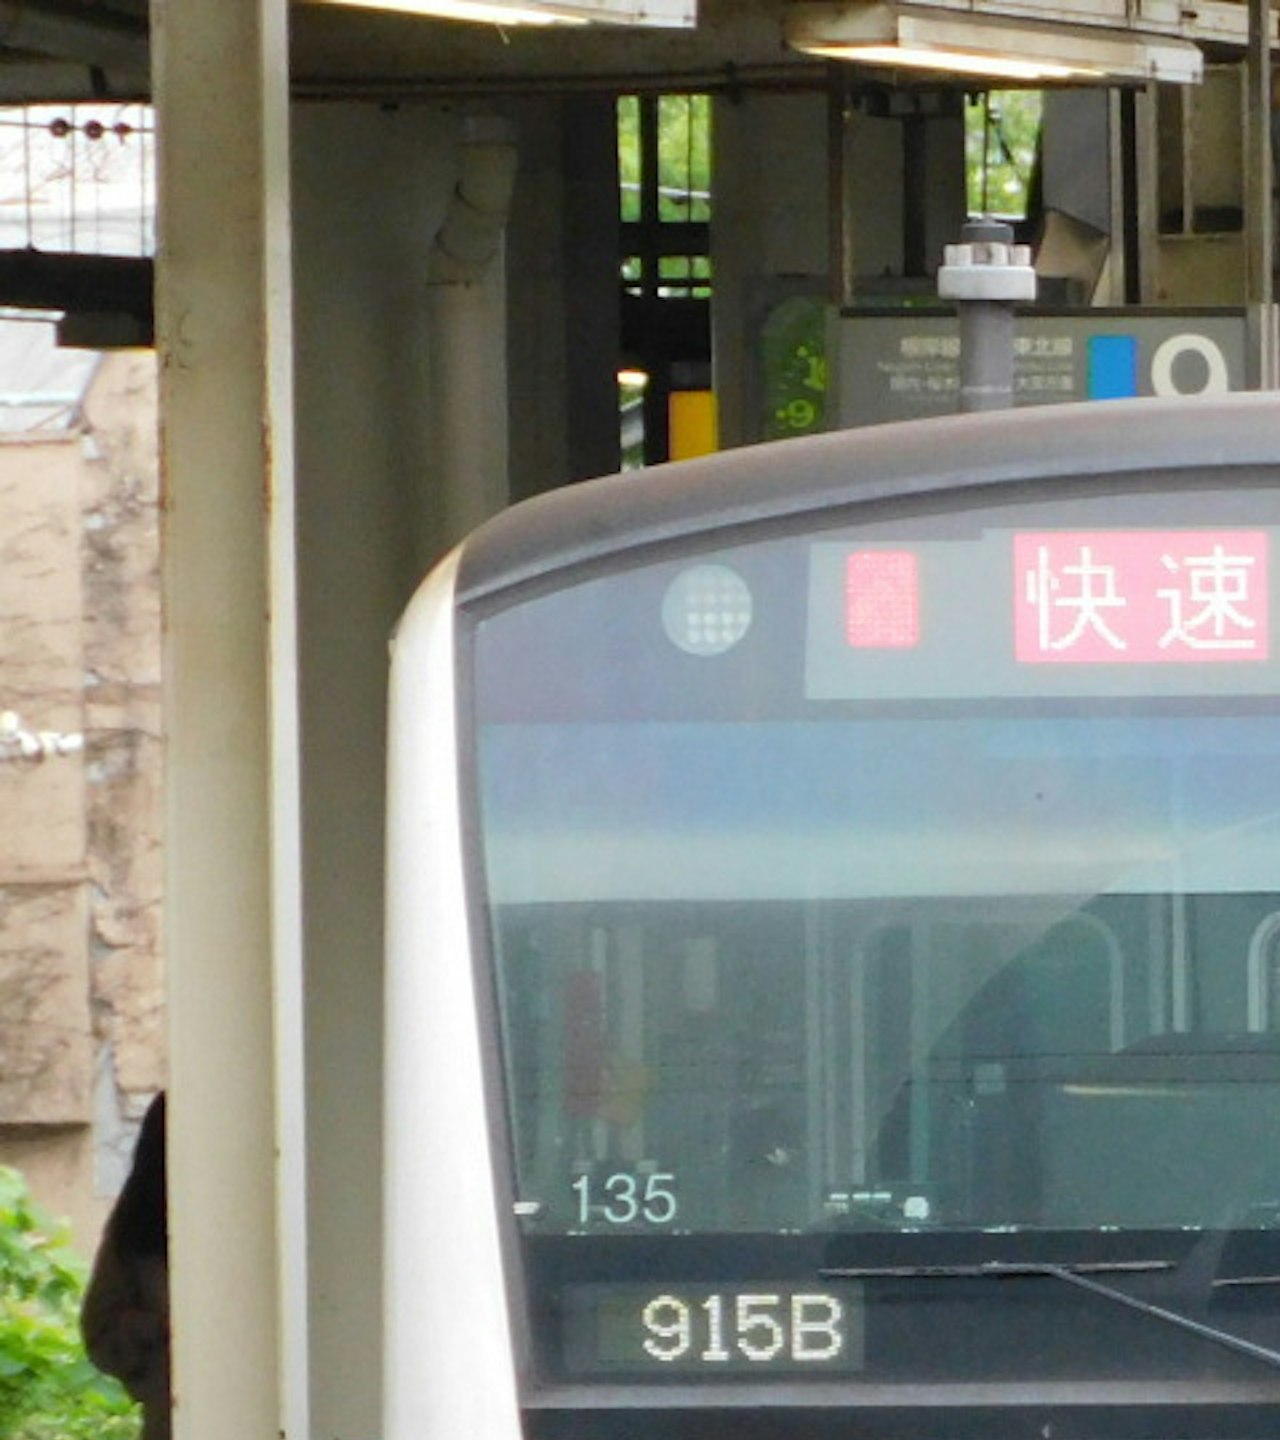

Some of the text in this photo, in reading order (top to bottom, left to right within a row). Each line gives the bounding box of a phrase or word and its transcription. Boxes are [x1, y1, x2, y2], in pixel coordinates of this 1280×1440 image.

[1026, 545, 1256, 651] 快速
[570, 1172, 679, 1226] 135
[640, 1291, 844, 1363] 915B
